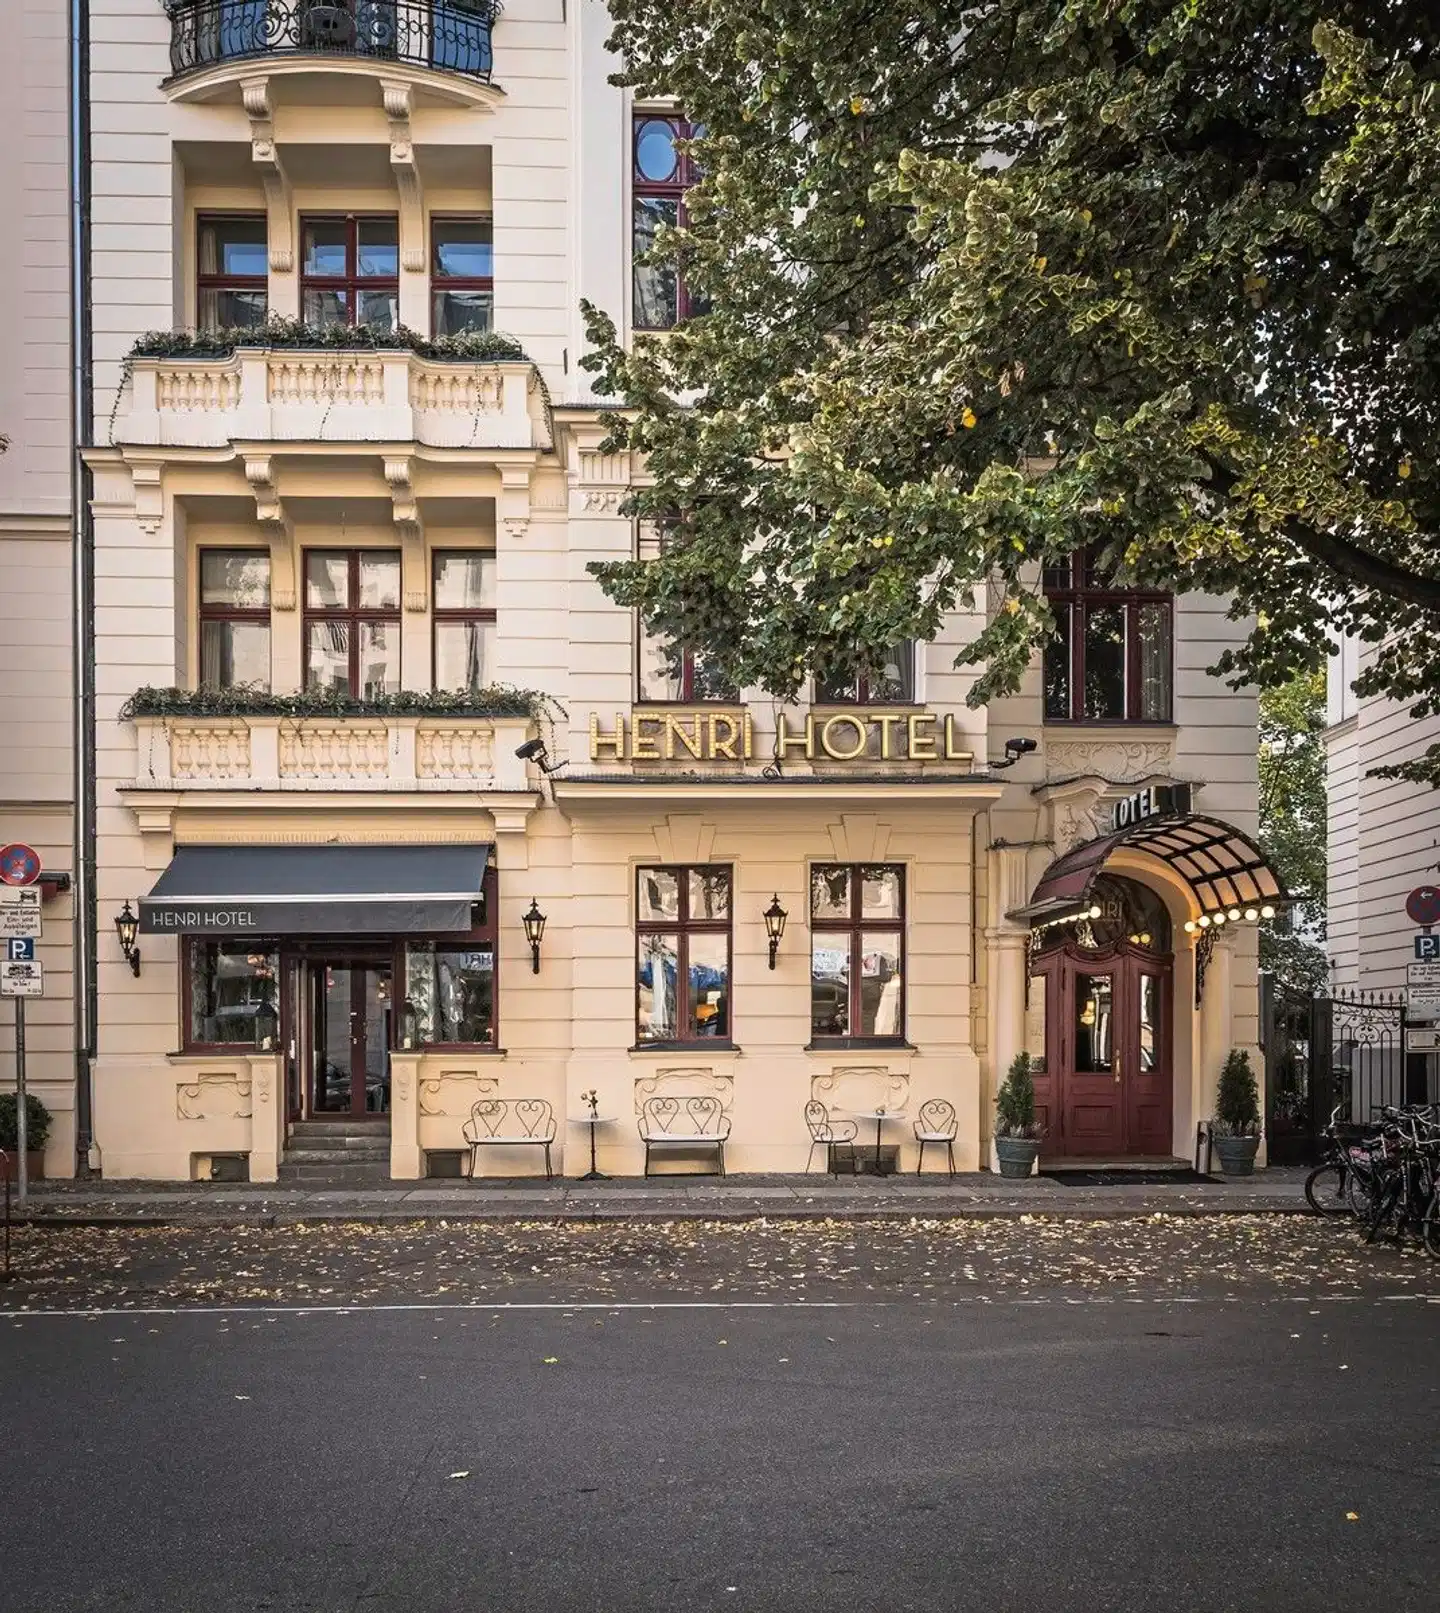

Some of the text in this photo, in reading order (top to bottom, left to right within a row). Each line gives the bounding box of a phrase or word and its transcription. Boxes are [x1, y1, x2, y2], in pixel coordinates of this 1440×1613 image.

[590, 712, 974, 761] HENRI HOTEL
[152, 911, 257, 926] HENRI HOTEL
[12, 940, 26, 959] P
[1419, 938, 1434, 956] P
